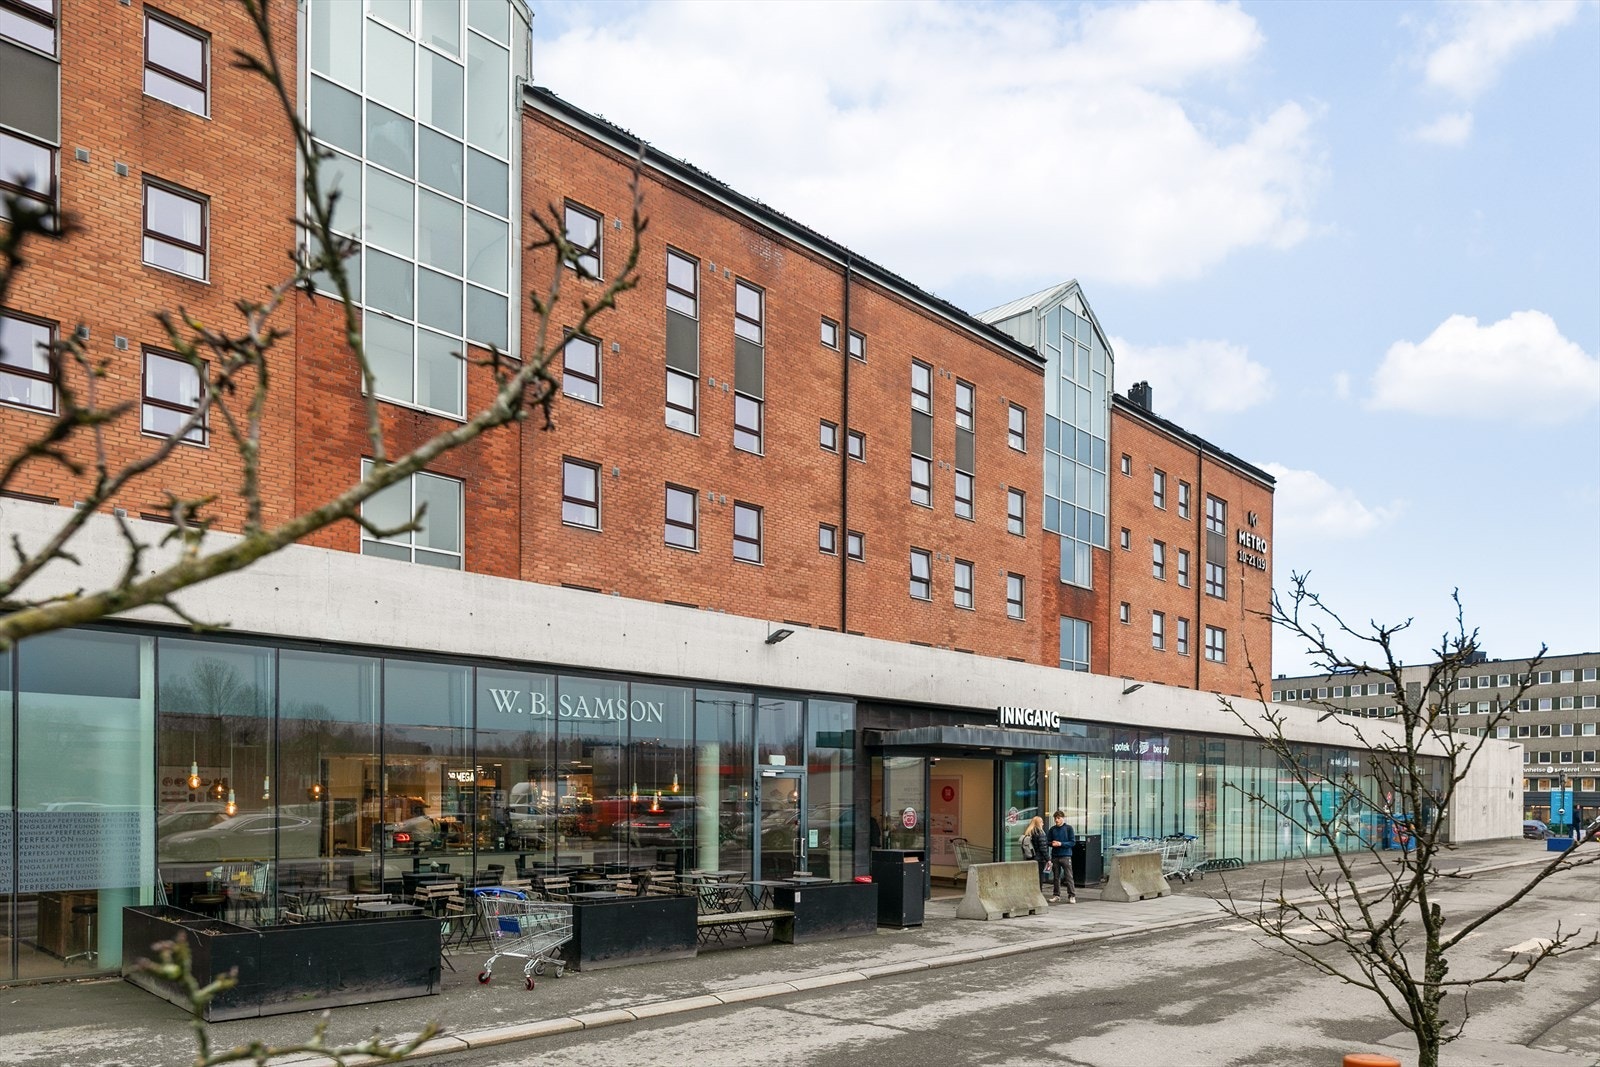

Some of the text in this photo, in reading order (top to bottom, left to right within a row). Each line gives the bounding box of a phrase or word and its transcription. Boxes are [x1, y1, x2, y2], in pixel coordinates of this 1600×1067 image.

[1238, 529, 1267, 554] METRO
[488, 688, 664, 724] W. B. SAMSON
[1000, 706, 1060, 728] INNGANG
[19, 882, 74, 891] PERFEKSJON
